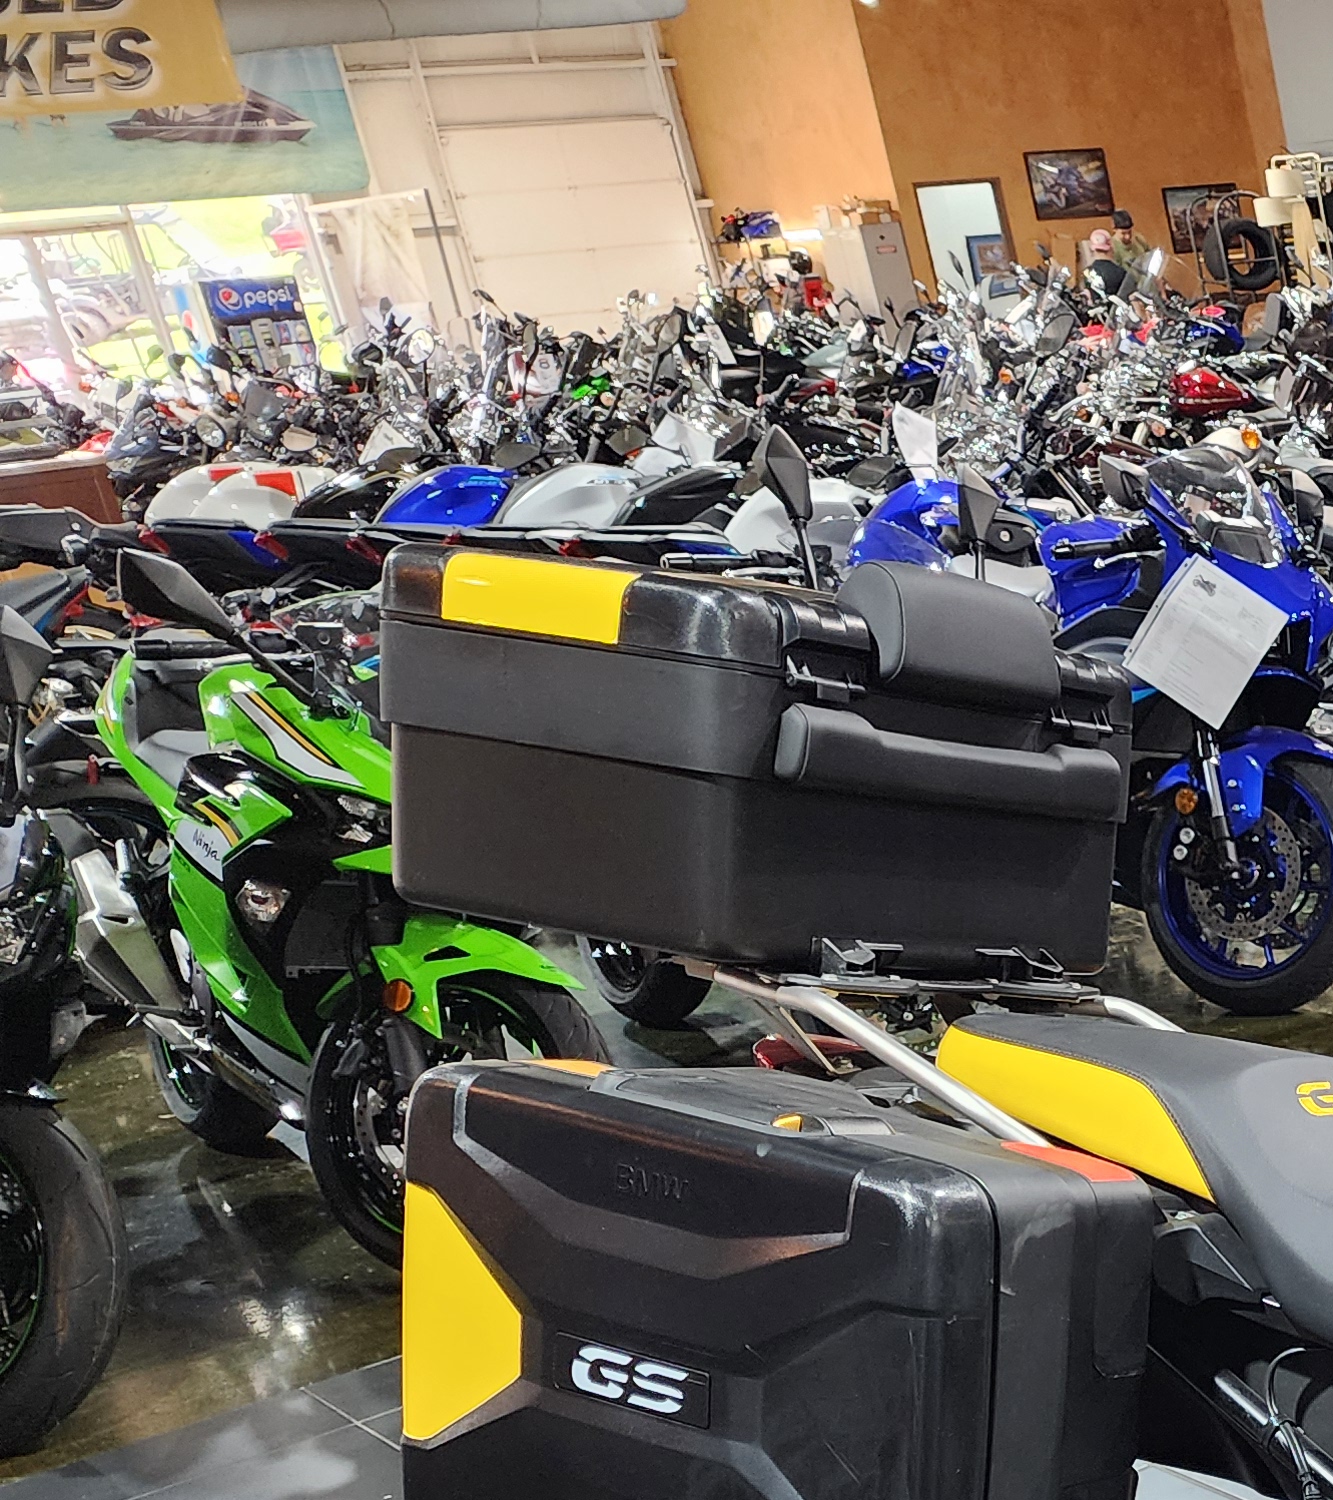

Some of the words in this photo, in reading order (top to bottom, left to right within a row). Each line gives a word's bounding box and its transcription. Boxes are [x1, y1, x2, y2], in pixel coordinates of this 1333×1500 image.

[243, 285, 294, 308] pepsi
[192, 828, 221, 862] Ninja
[571, 1345, 689, 1415] GS
